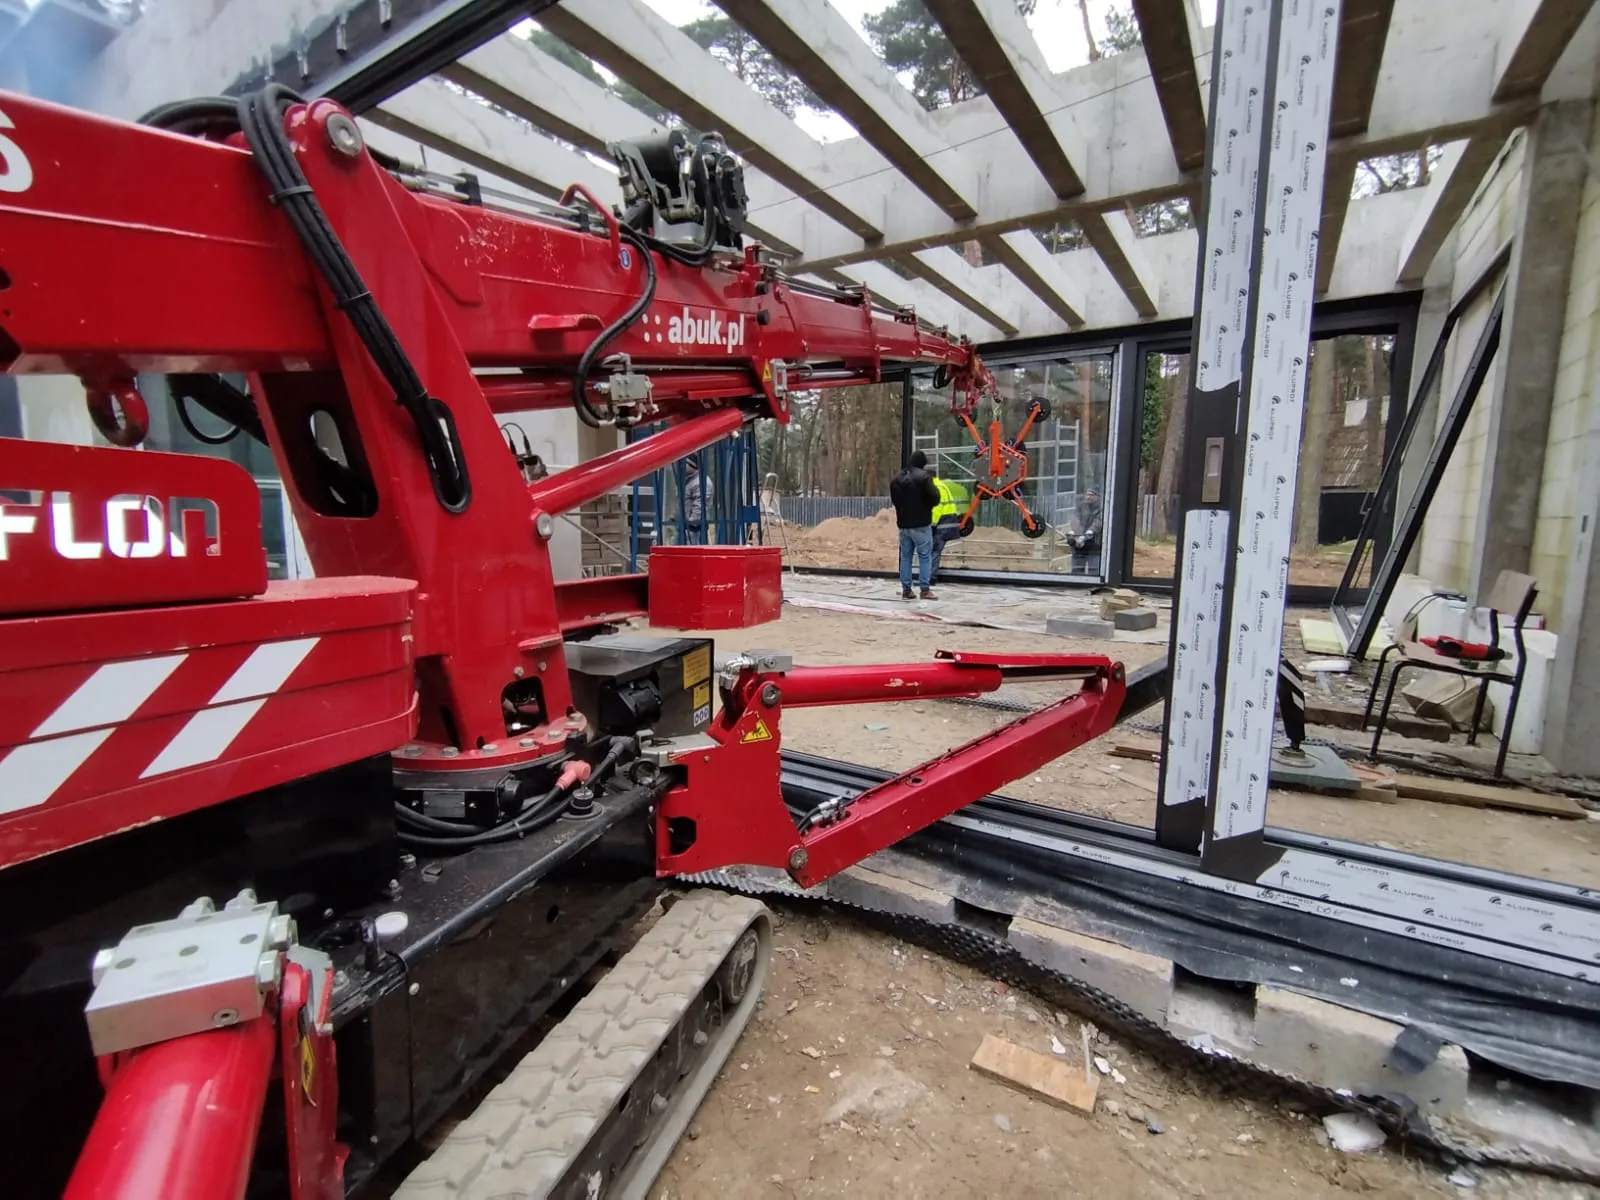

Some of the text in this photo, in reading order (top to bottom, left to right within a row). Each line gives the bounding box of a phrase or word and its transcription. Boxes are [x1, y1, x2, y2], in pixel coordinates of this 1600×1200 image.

[668, 306, 744, 353] abuk.pl
[1082, 850, 1111, 860] ALUPROF
[1350, 865, 1390, 876] ALUPROF
[1293, 876, 1331, 888] ALUPROF
[1393, 889, 1436, 900] ALUPROF
[1505, 903, 1555, 916] ALUPROF
[1438, 914, 1485, 927] ALUPROF
[1420, 931, 1465, 946] ALUPROF
